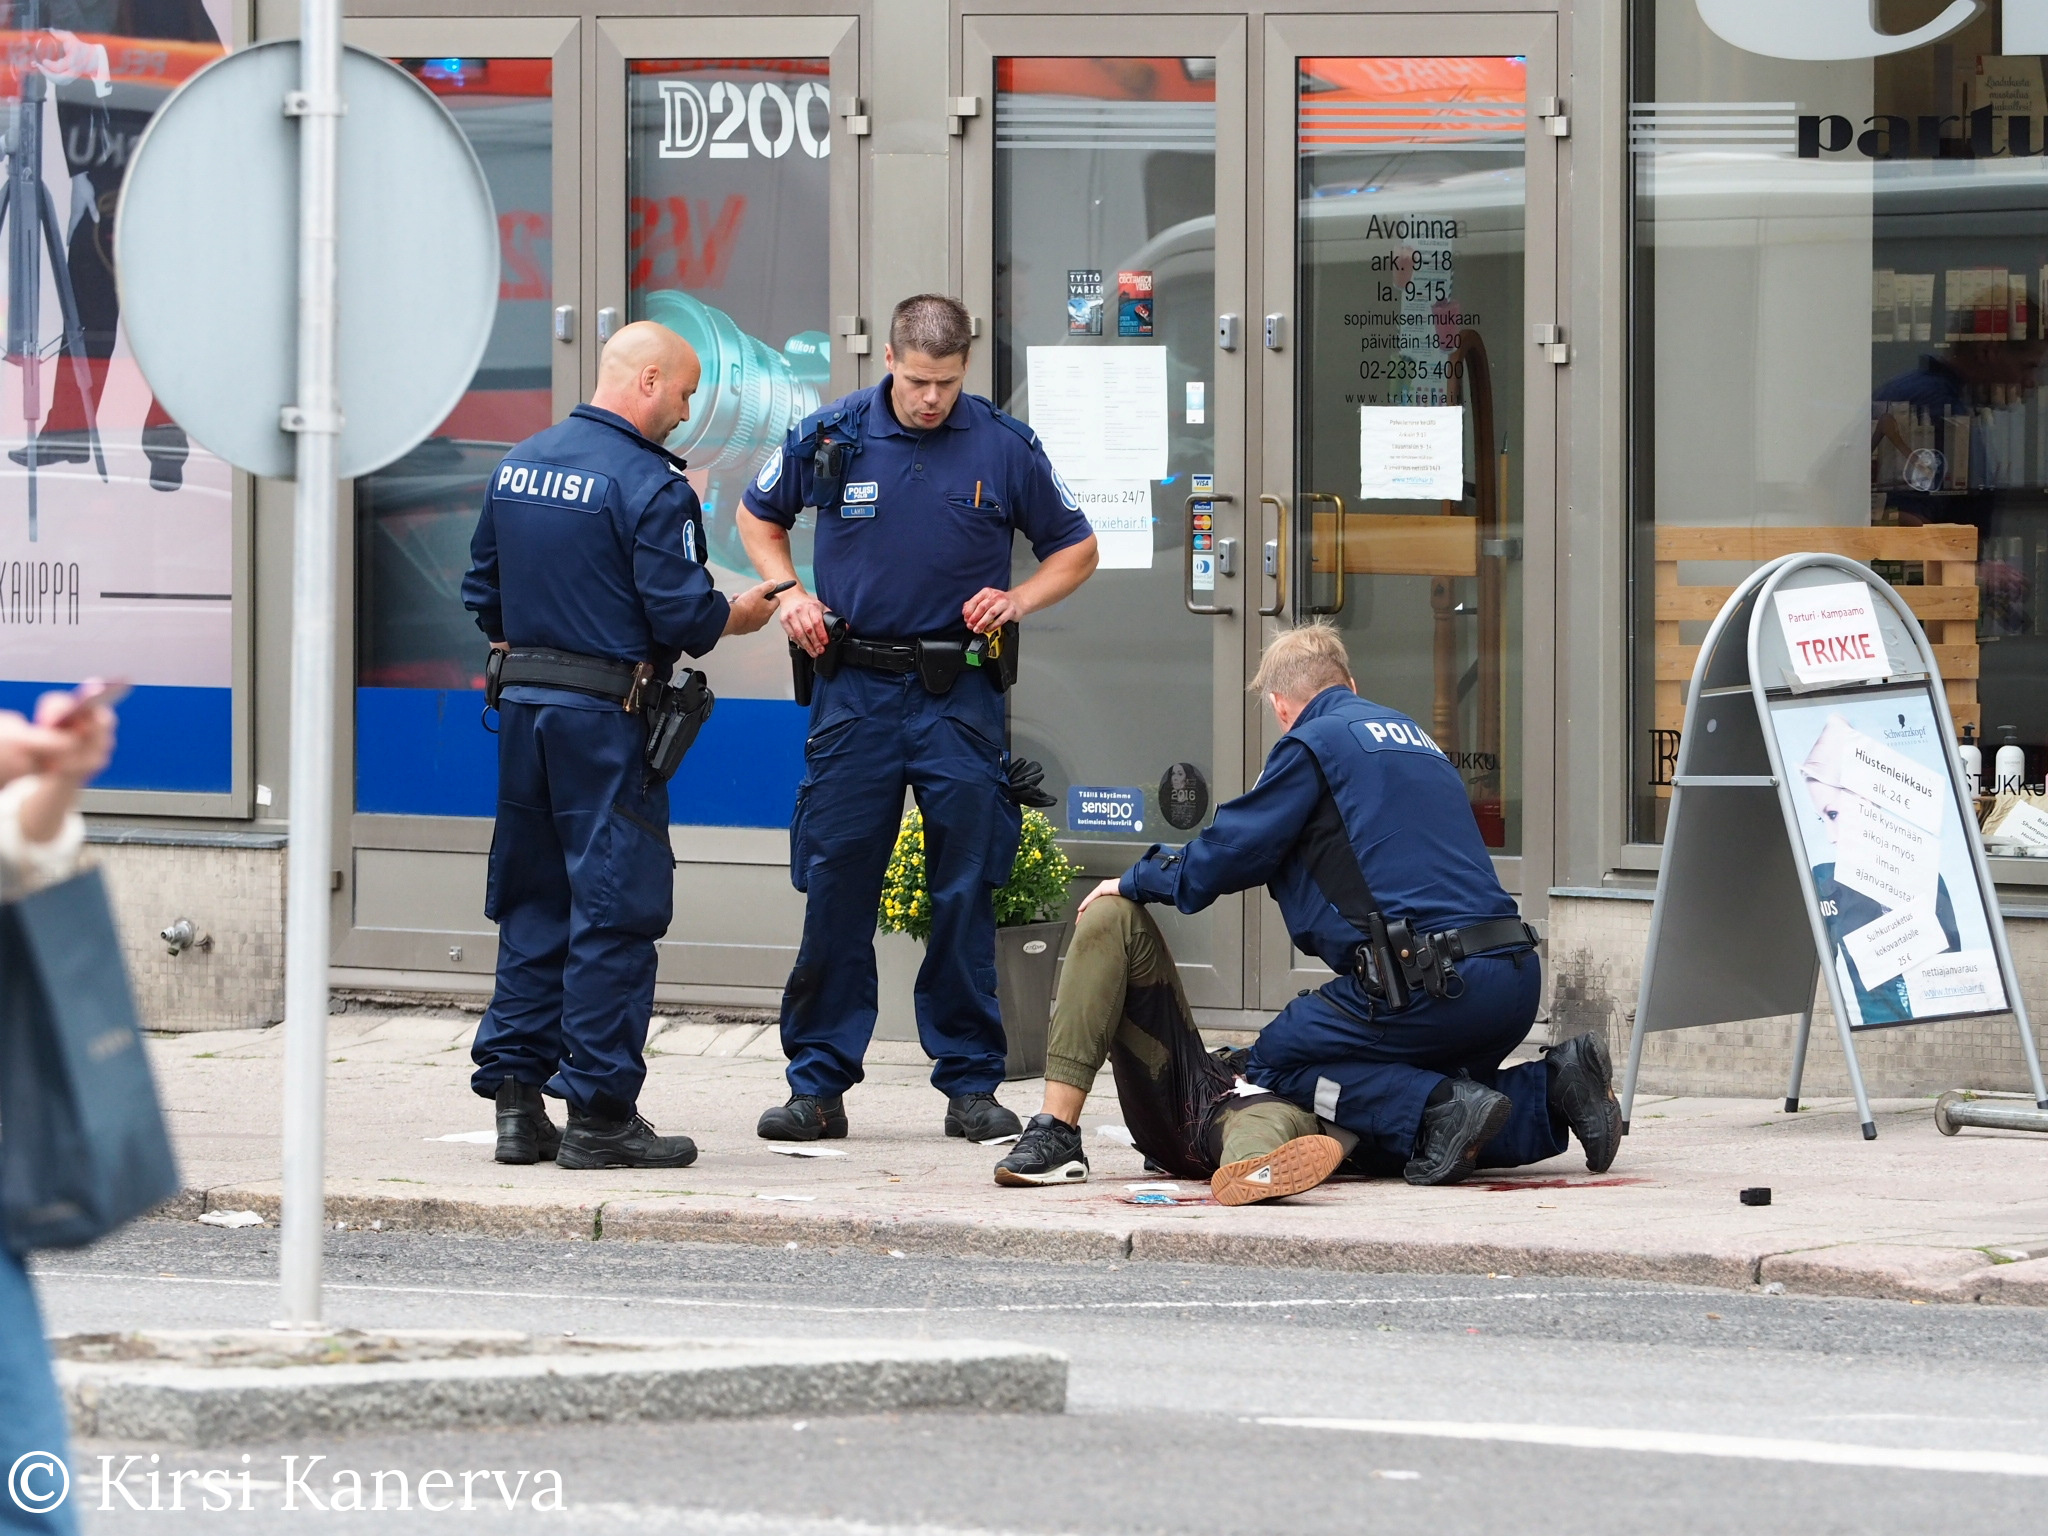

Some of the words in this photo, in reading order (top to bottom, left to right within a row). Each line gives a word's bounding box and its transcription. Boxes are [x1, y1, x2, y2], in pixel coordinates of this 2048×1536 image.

[1366, 214, 1457, 239] Avoinna
[1371, 251, 1404, 271] ark.
[1412, 251, 1452, 271] 9-18
[1377, 281, 1397, 301] la.
[1405, 281, 1445, 301] 9-15
[1344, 311, 1423, 329] sopimuksen
[1428, 311, 1480, 325] mukaan
[789, 340, 816, 354] Nikon
[1361, 334, 1419, 352] päivittäin
[1425, 334, 1462, 349] 18-20
[1360, 361, 1427, 379] 02-2335
[1433, 361, 1464, 379] 400
[498, 466, 594, 503] POLIISI
[848, 486, 873, 495] POLIISI
[1122, 491, 1144, 504] 24/7
[1788, 611, 1815, 623] Parturi
[1820, 607, 1864, 620] Kampaamo
[1796, 633, 1875, 666] TRIXIE
[1884, 725, 1926, 739] Schwarzkopf
[1855, 747, 1933, 798] Hiustenleikkaus
[1171, 790, 1196, 801] 2016
[1859, 803, 1878, 821] Tule
[1880, 815, 1923, 845] kysymään
[1862, 829, 1889, 849] aikoja
[1891, 844, 1915, 862] myös
[1875, 855, 1900, 876] ilman
[1866, 913, 1914, 943] Suihkurusketus
[1874, 928, 1919, 958] kokovartalolle
[1898, 957, 1907, 966] 25
[1921, 964, 1978, 978] nettiajanvaraus
